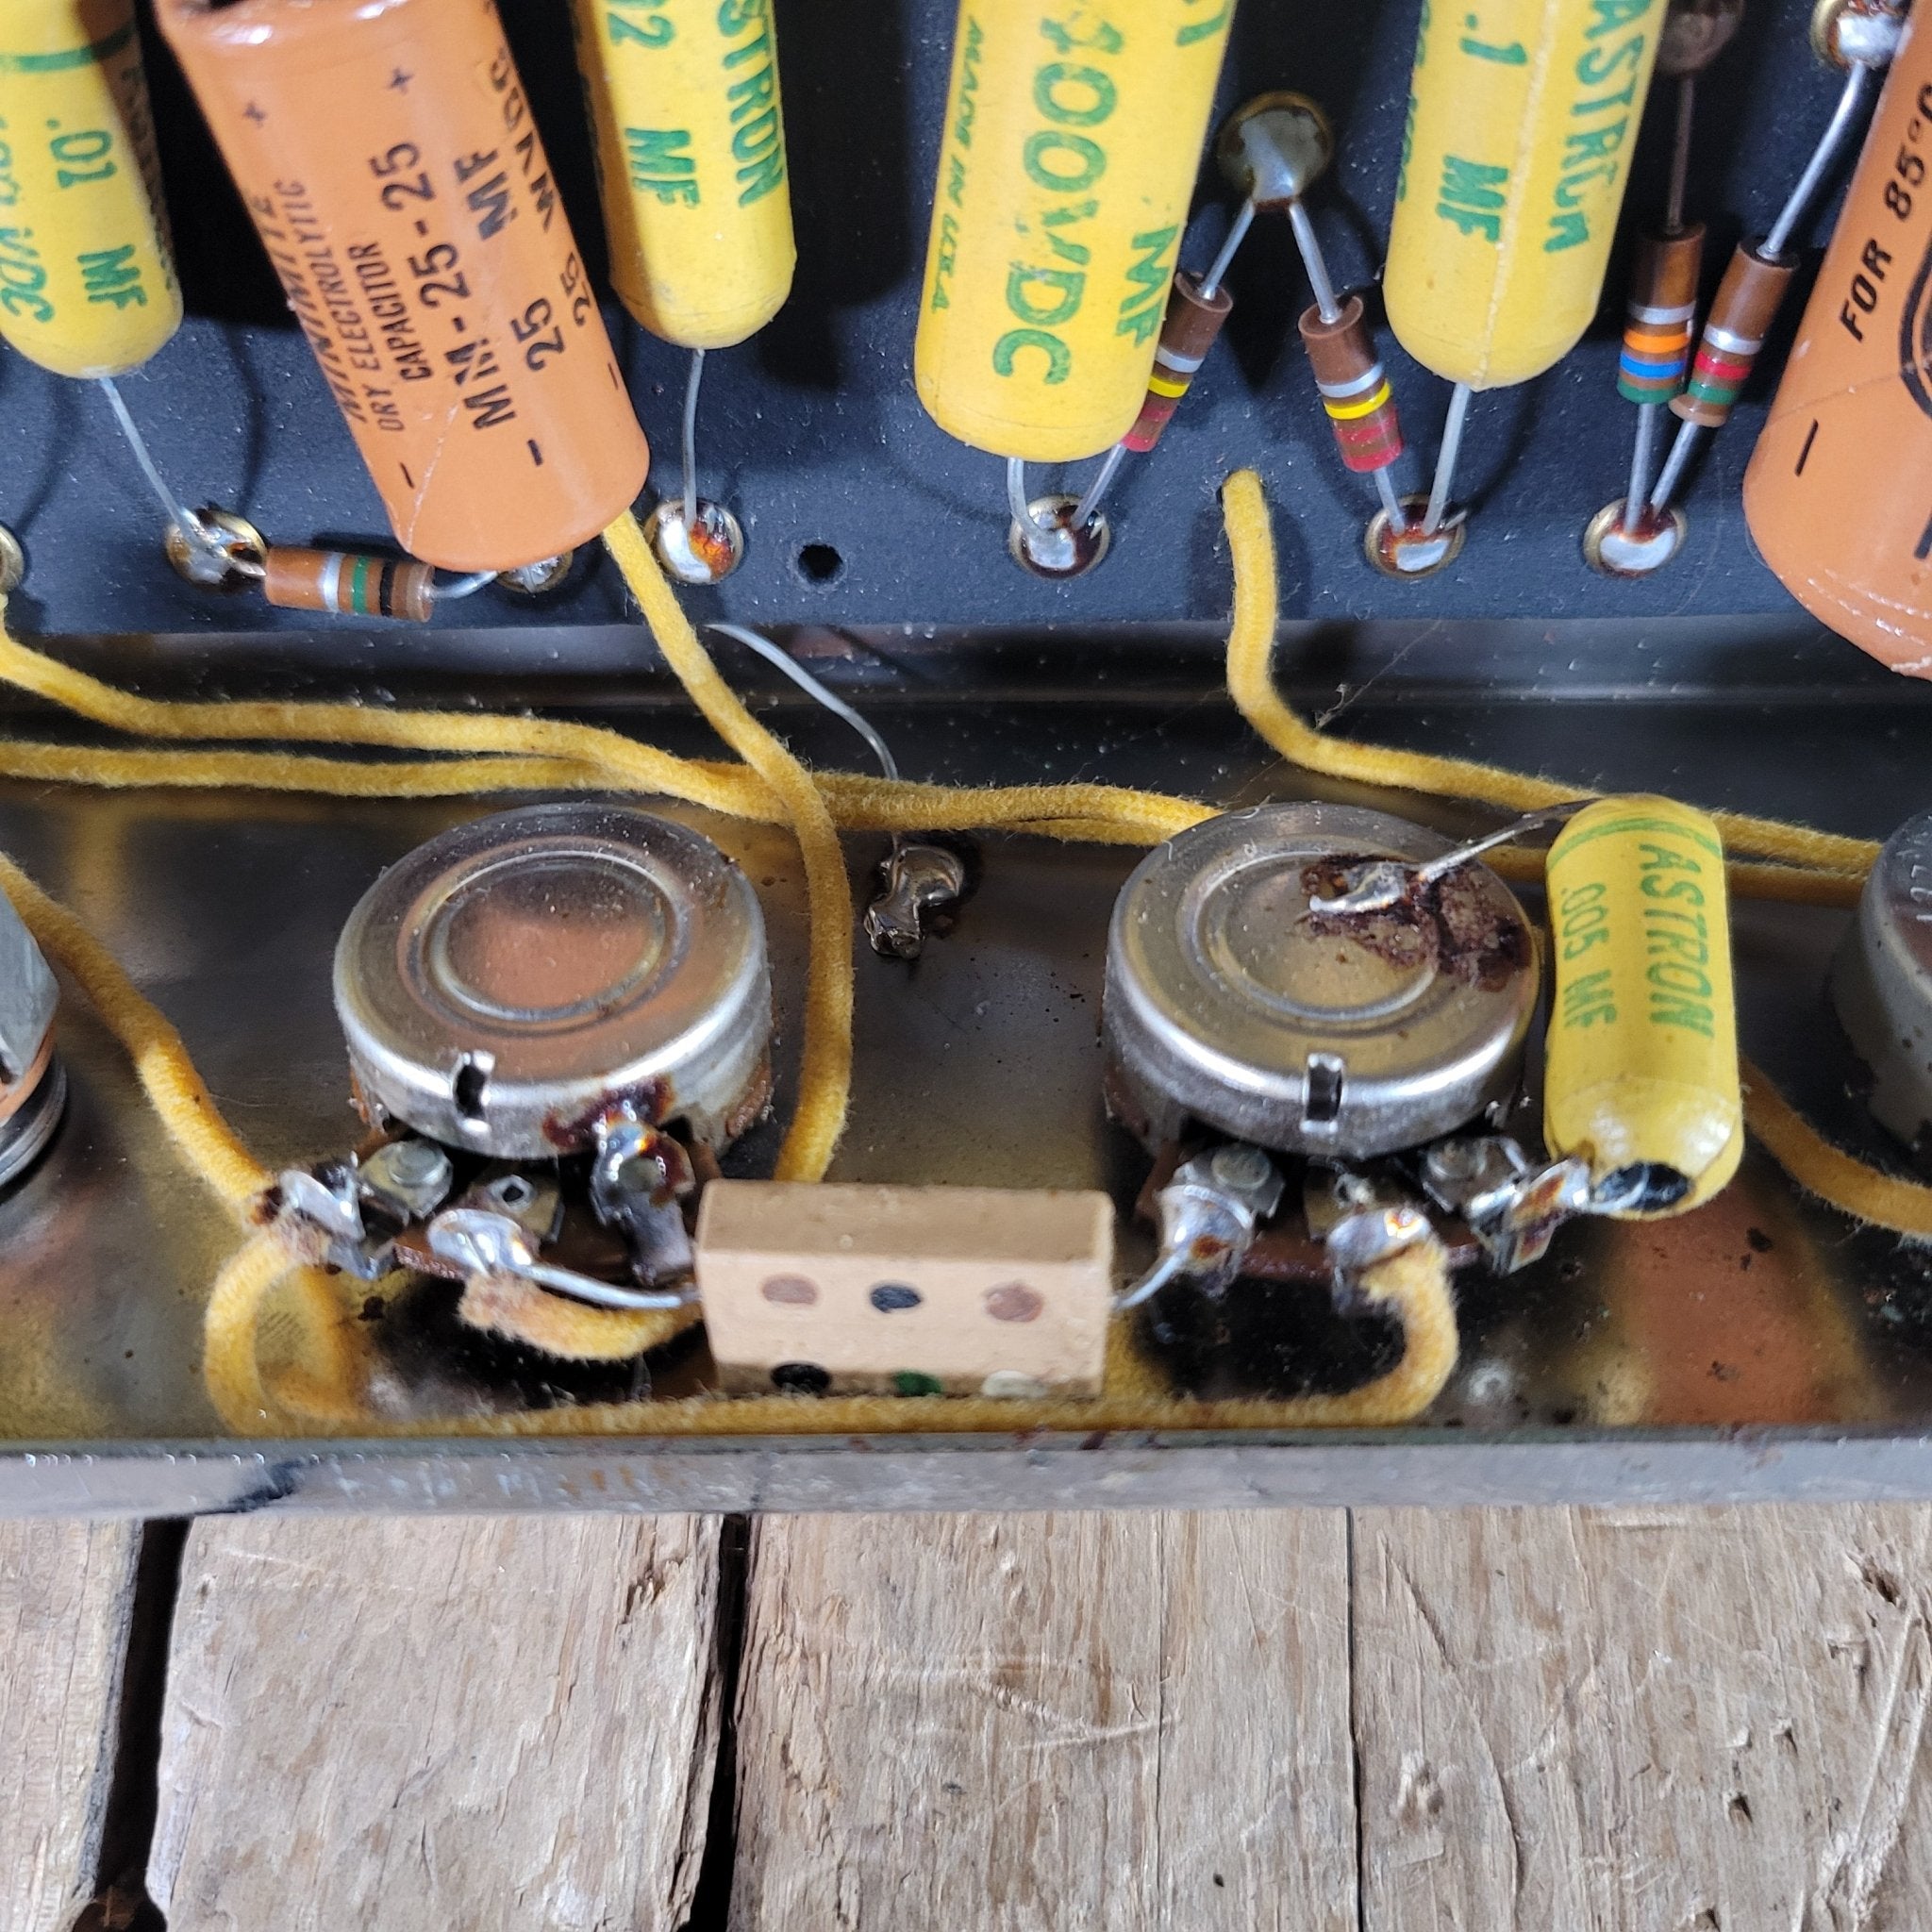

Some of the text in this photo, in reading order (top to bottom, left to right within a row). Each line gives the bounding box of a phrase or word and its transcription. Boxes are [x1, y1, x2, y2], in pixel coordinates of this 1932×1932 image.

[46, 117, 118, 189] .01
[625, 127, 701, 209] MF
[1435, 12, 1527, 243] .1 MF
[948, 154, 966, 208] IN
[77, 243, 148, 311] MF
[273, 177, 406, 432] DRY ELECTROLYTIC
[348, 242, 433, 381] CAPACITOR
[454, 150, 565, 371] 25 MF
[560, 251, 592, 327] 25
[1116, 224, 1179, 347] MF
[1840, 238, 1892, 343] FOR
[1639, 842, 1715, 1040] ASTRON
[1563, 969, 1619, 1029] MF
